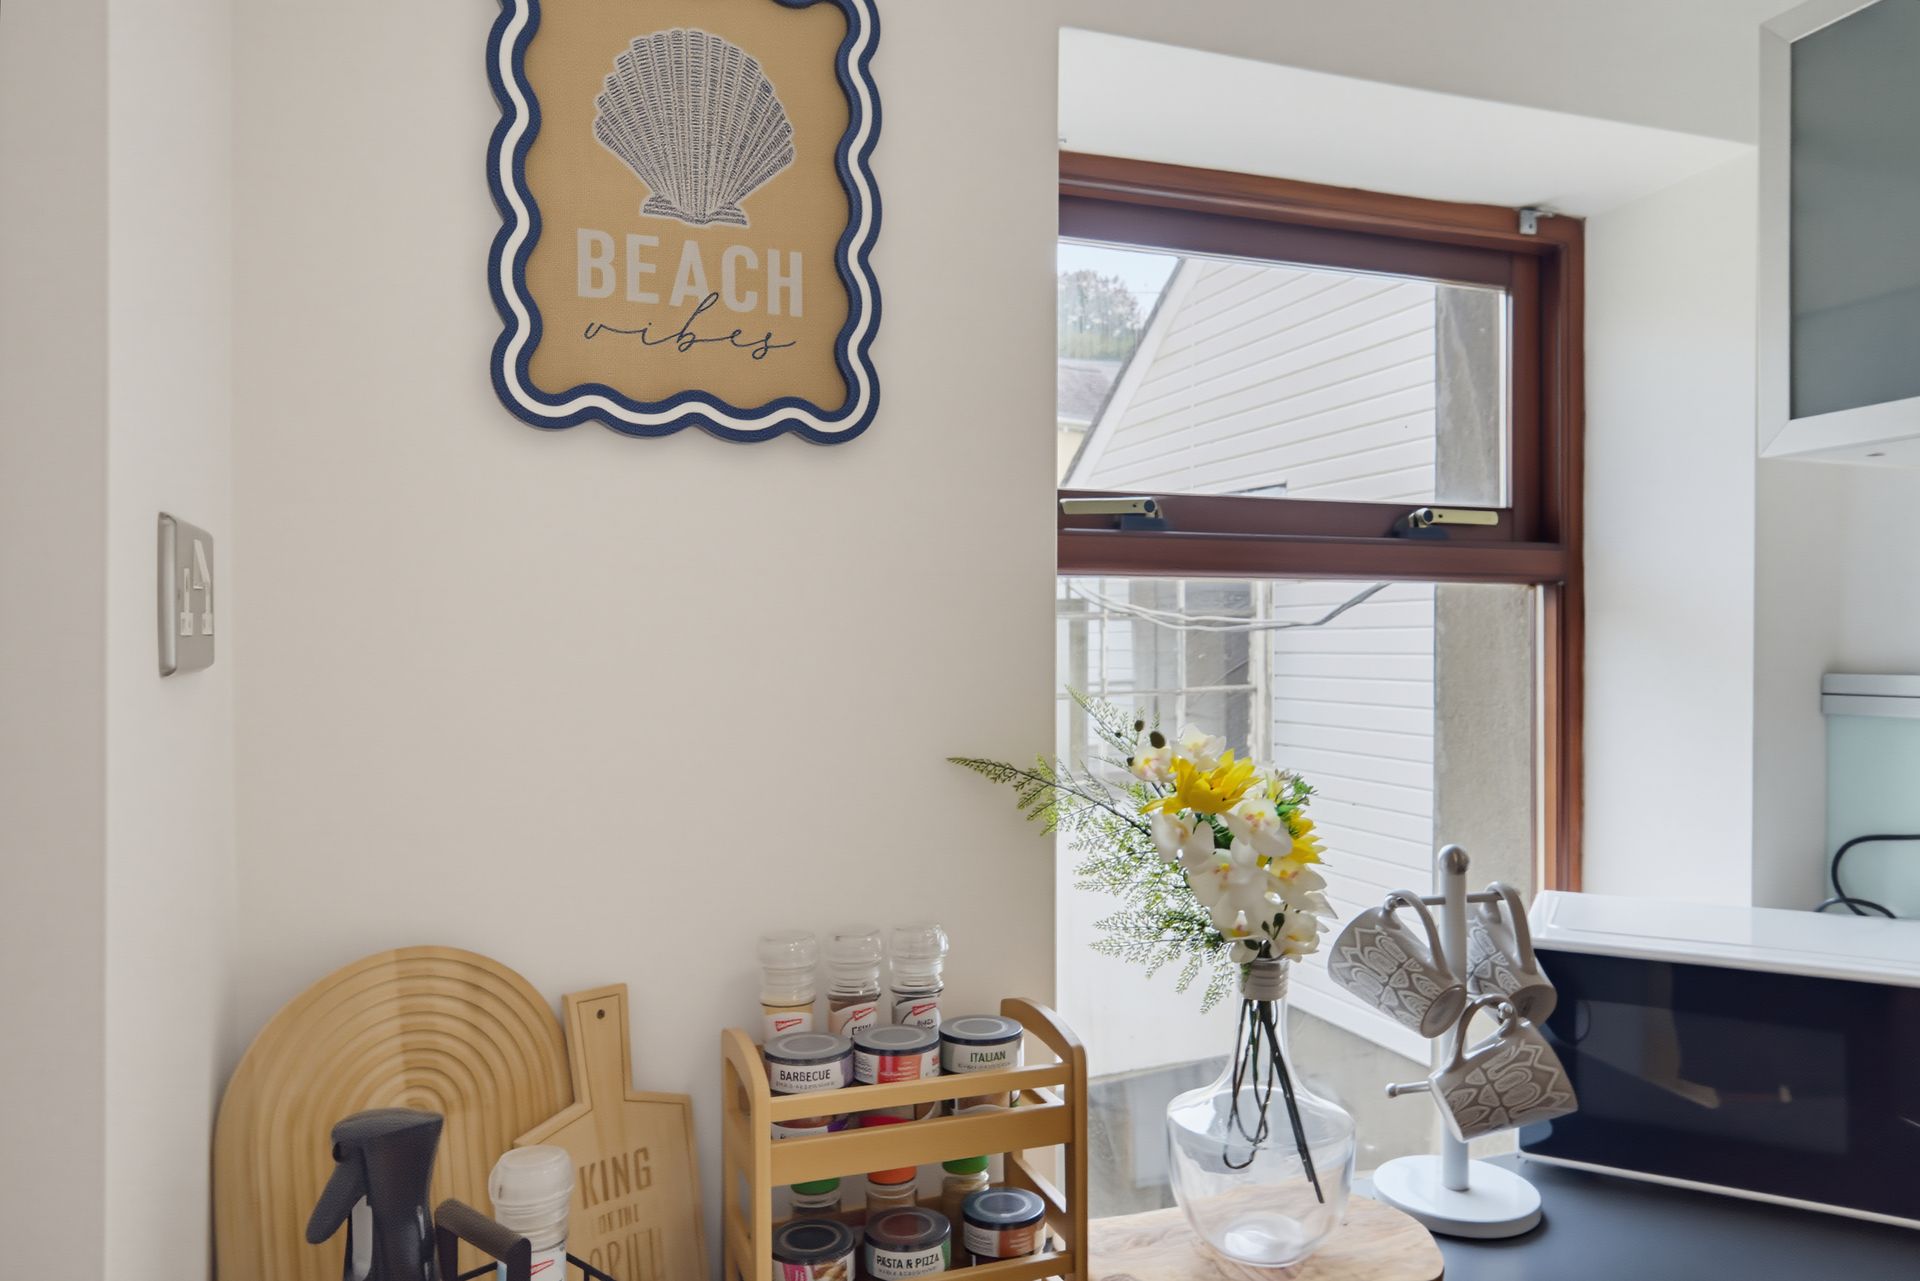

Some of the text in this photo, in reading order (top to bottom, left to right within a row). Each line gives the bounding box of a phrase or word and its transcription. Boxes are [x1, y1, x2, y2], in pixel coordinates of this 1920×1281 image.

[578, 229, 803, 317] BEACH
[583, 292, 797, 360] vibes
[970, 1050, 1006, 1063] ITALIAN
[780, 1069, 831, 1082] BARBECUE
[579, 1147, 653, 1210] KING
[598, 1204, 640, 1234] OF THE
[876, 1253, 940, 1269] PASTA & PIZZA
